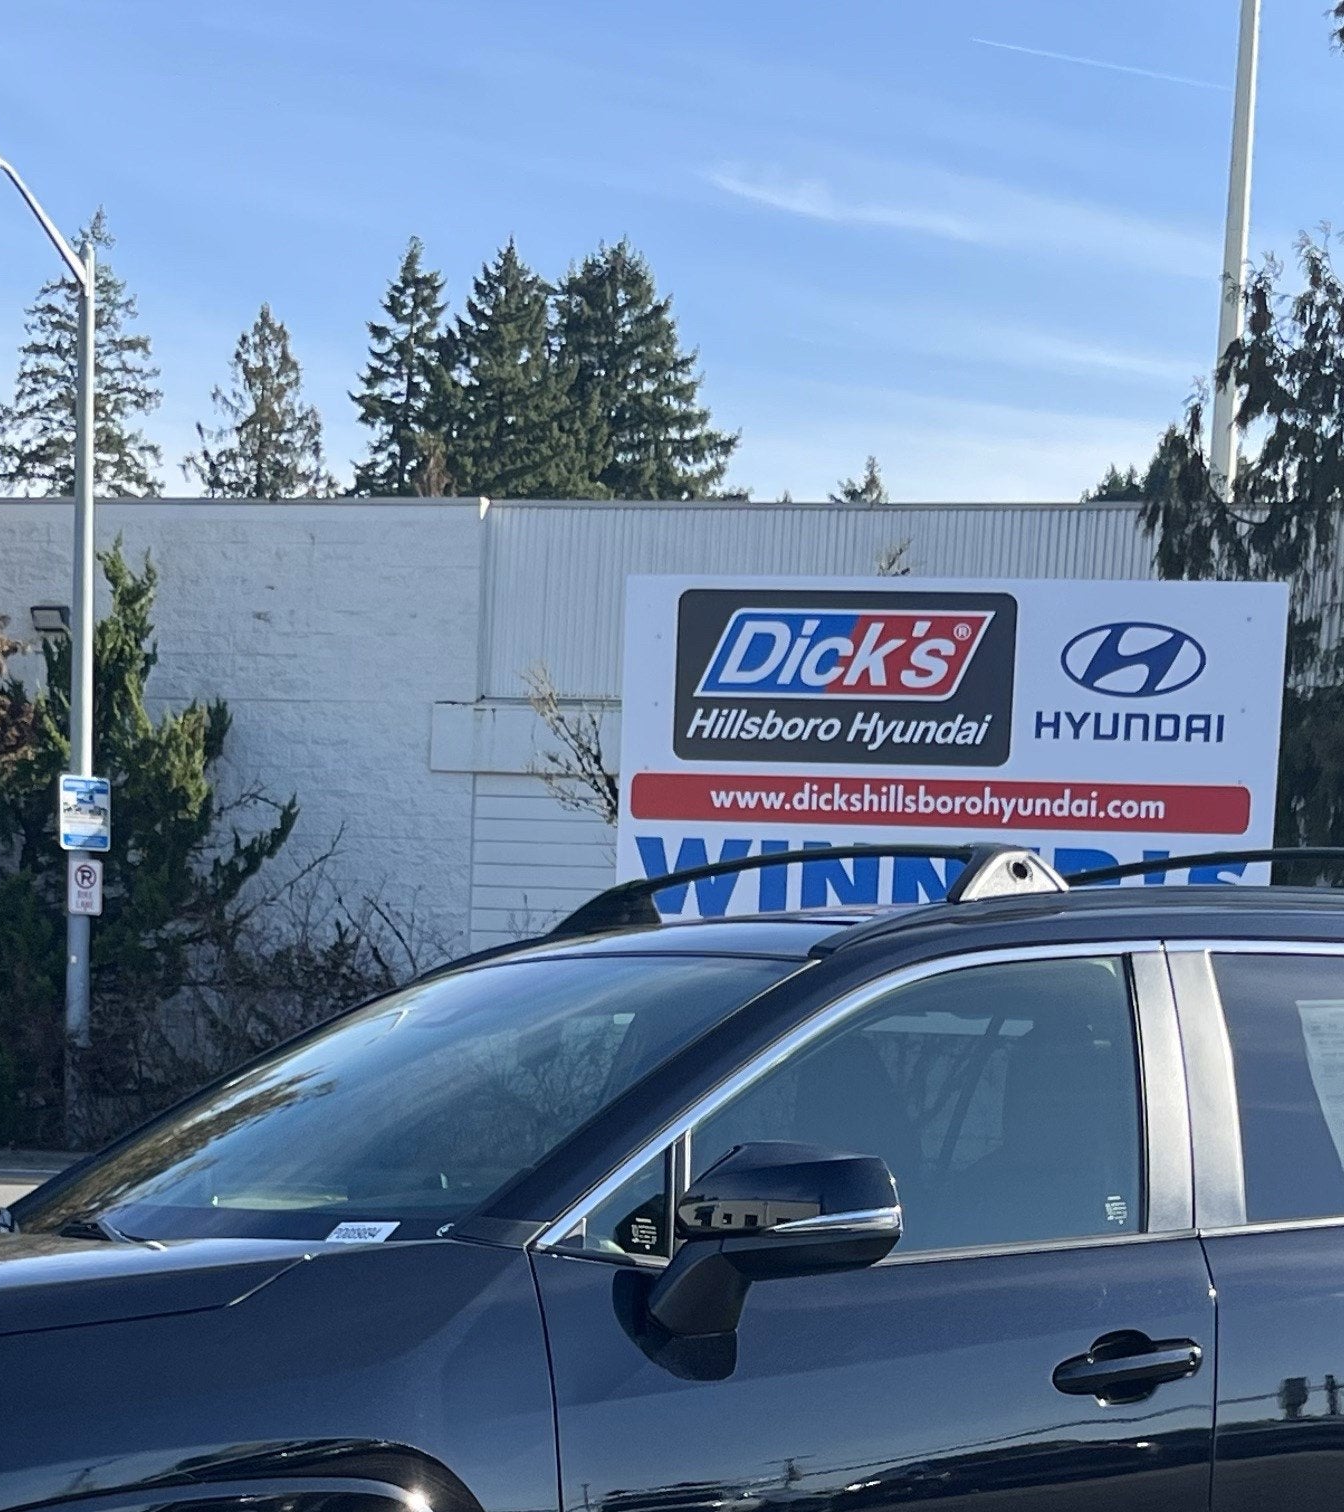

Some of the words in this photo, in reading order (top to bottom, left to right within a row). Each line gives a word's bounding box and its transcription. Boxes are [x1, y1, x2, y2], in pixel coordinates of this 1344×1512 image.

[718, 619, 956, 689] Dick's
[686, 708, 842, 744] Hillsboro
[847, 711, 994, 751] Hyundai
[1034, 711, 1226, 743] HYUNDAI
[710, 781, 1166, 823] www.dickshillsborohyundai.com
